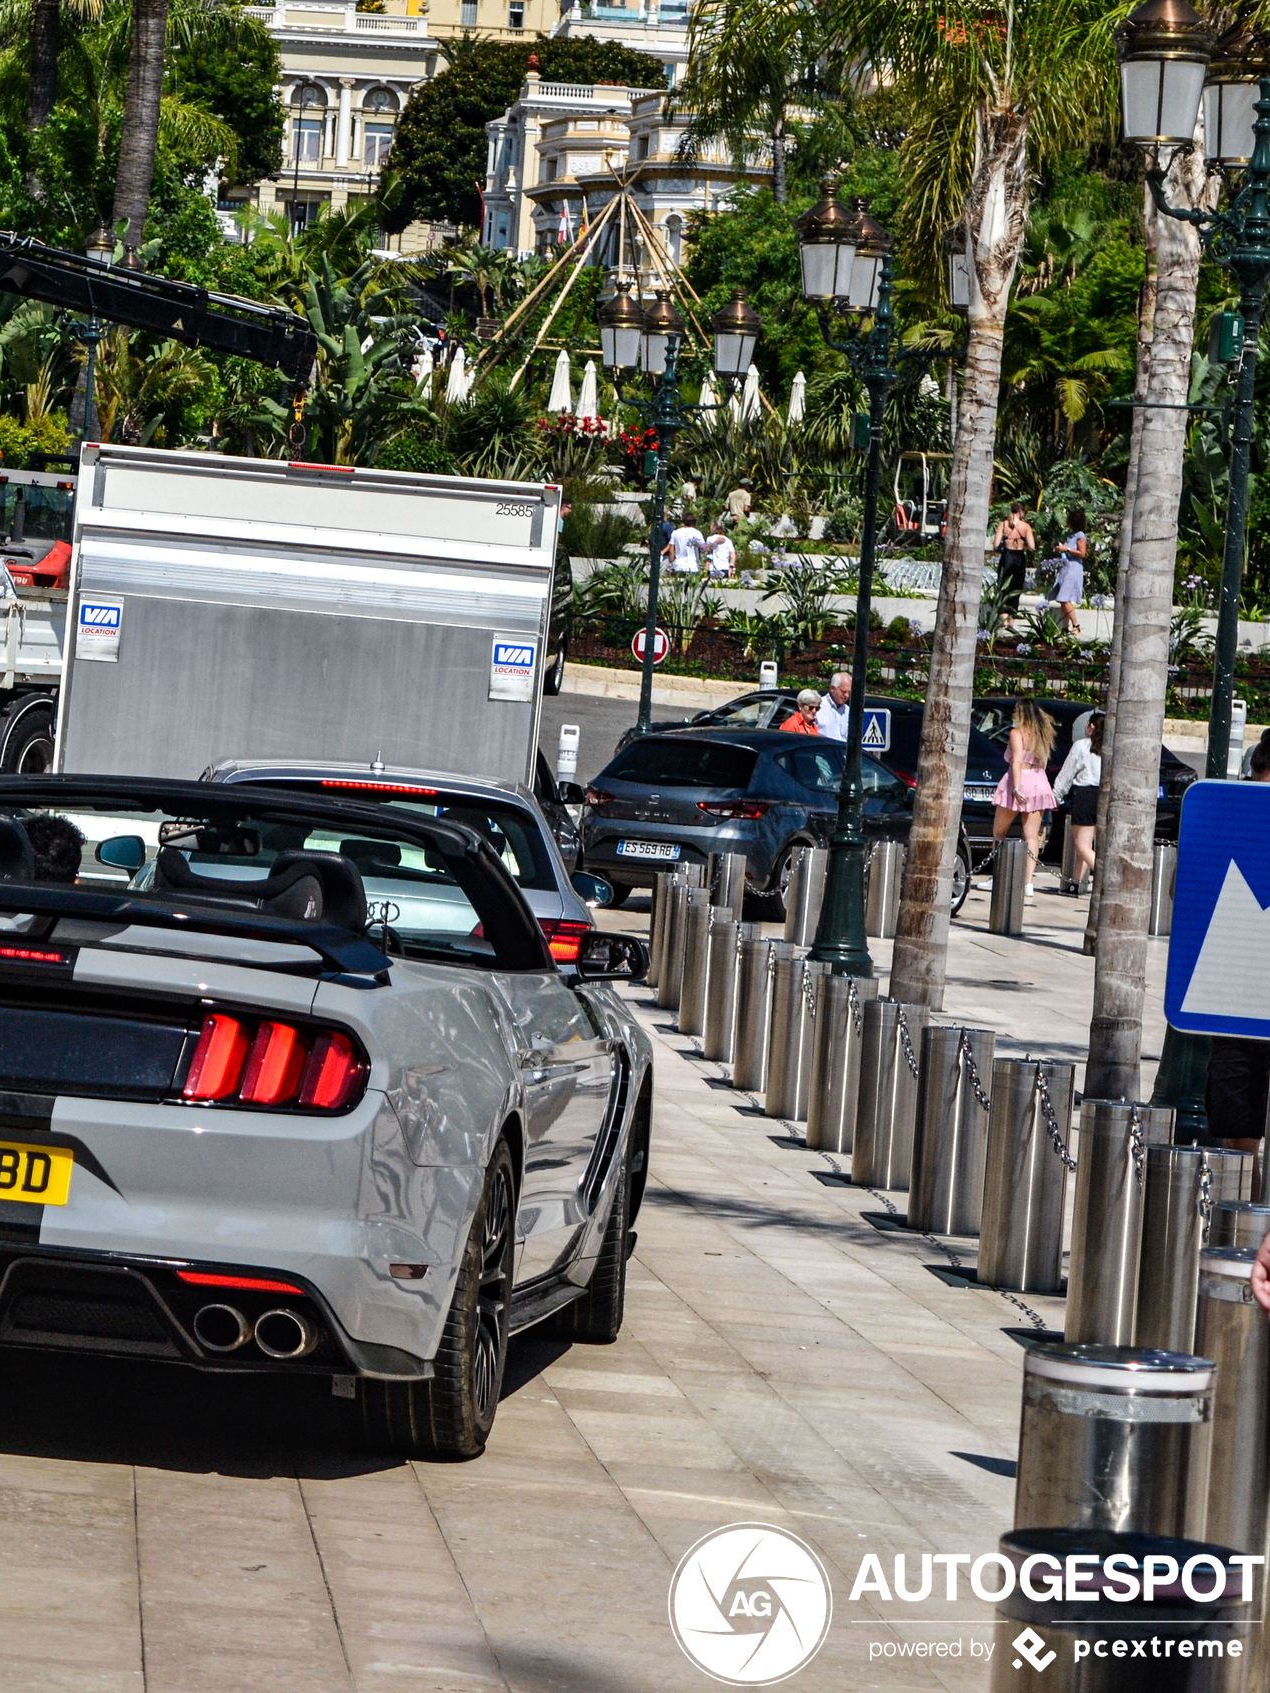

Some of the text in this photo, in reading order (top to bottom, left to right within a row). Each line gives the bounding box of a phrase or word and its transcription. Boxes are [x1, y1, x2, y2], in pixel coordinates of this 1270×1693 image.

[496, 502, 533, 518] 25585
[84, 607, 118, 625] VIA
[81, 627, 117, 636] LOCATION
[497, 646, 532, 665] VIA
[494, 667, 530, 676] LOCATION
[981, 788, 996, 799] 106
